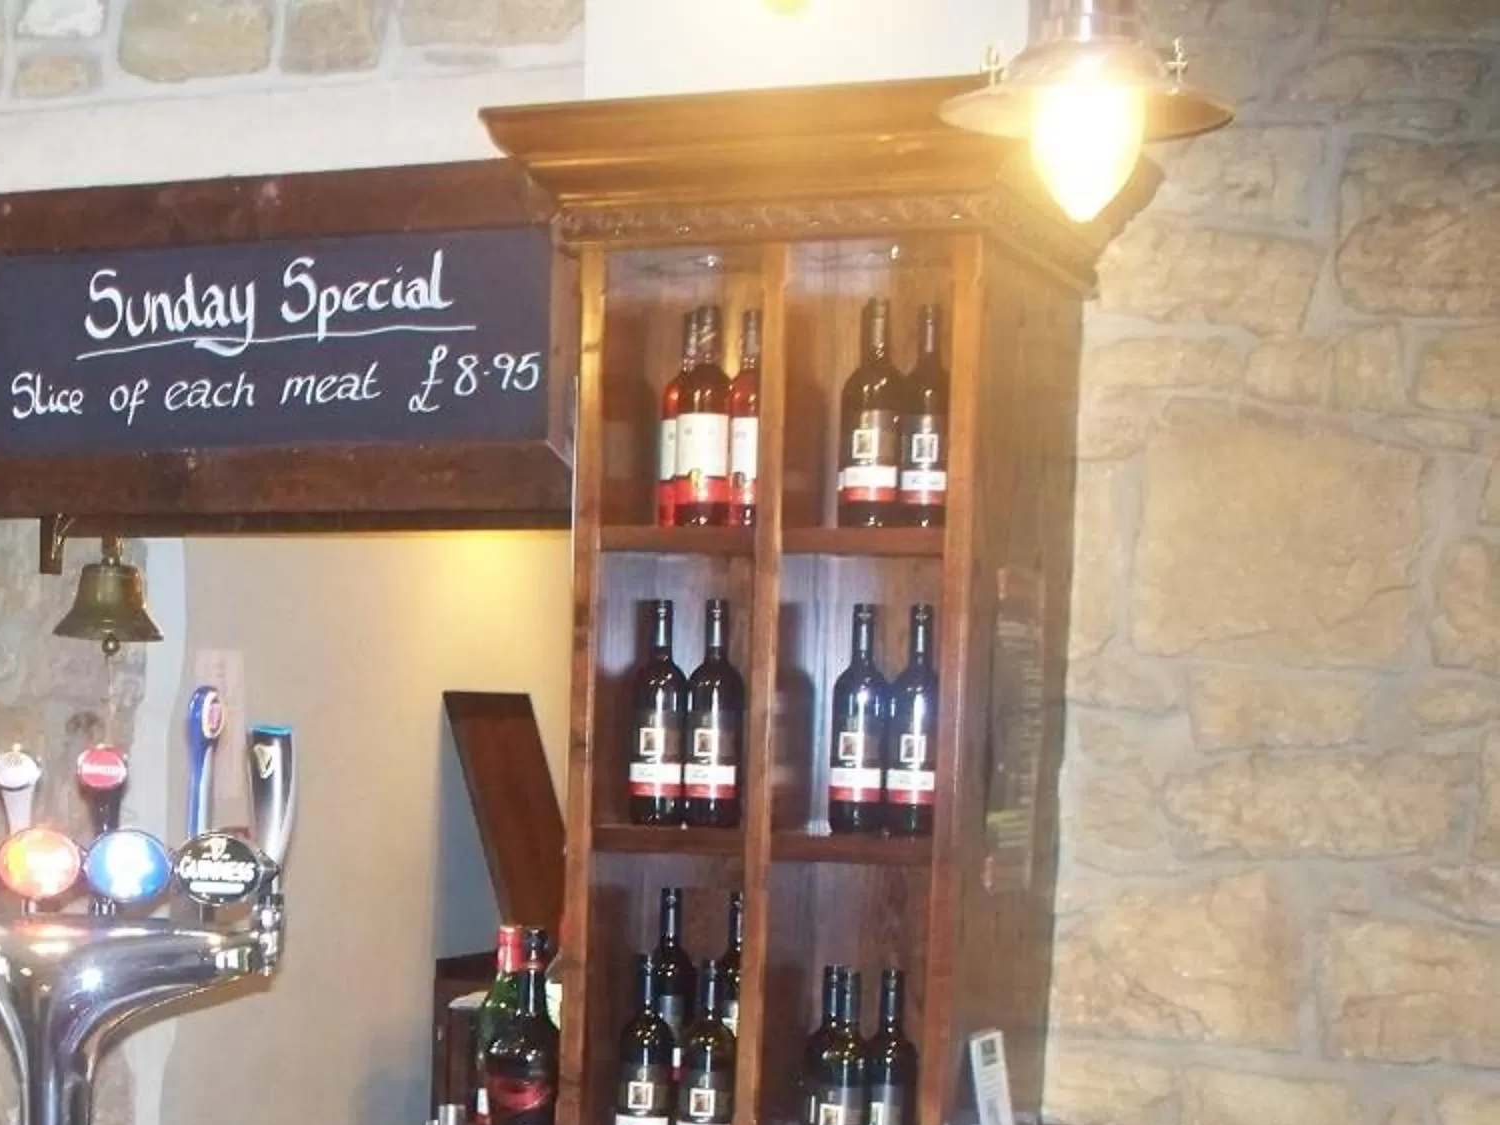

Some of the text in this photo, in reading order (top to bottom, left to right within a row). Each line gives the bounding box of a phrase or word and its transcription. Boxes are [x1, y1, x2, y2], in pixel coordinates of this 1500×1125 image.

[84, 249, 454, 357] Sunday Special
[11, 371, 83, 419] Slice
[109, 378, 149, 425] of
[164, 371, 255, 410] each
[279, 361, 381, 405] meat
